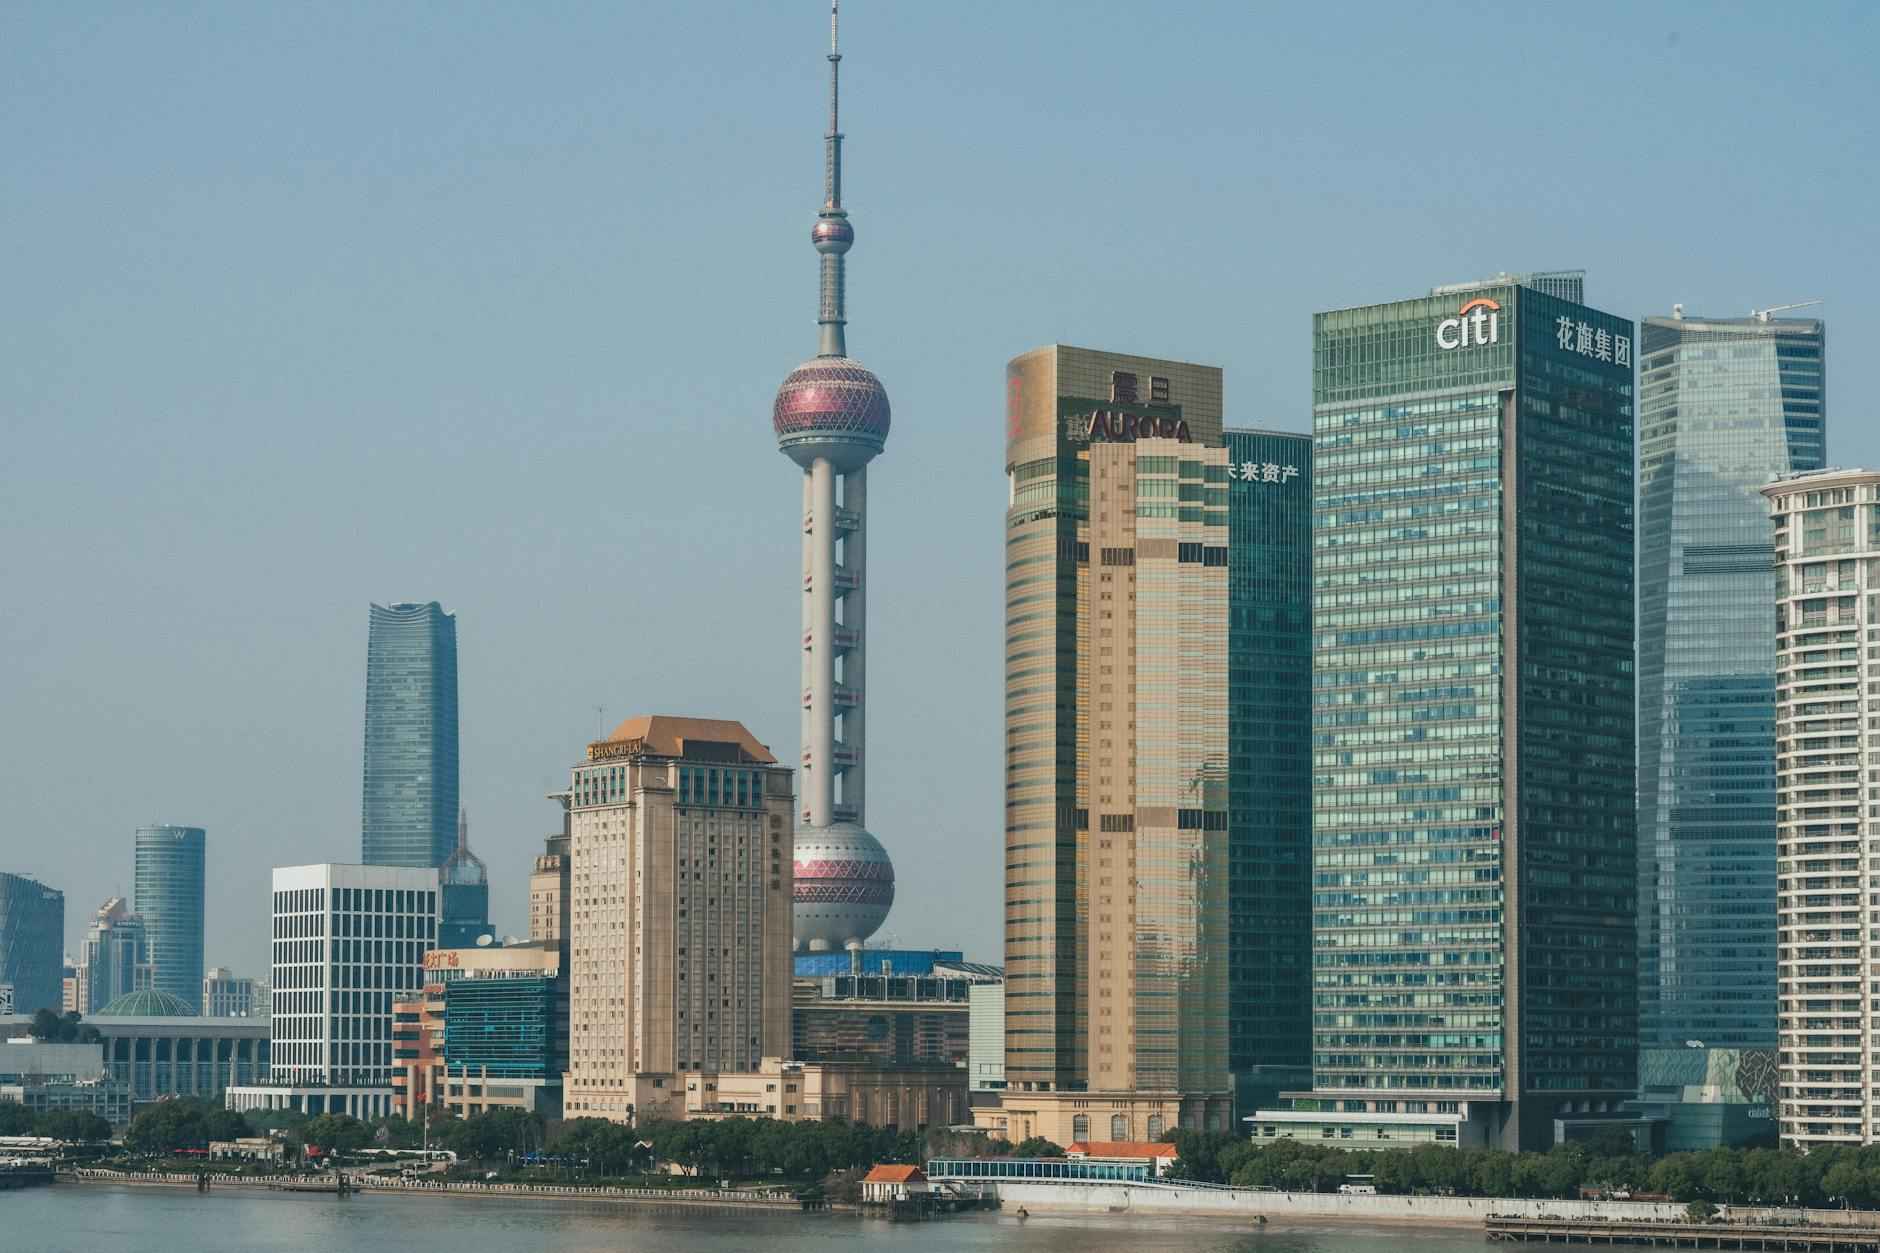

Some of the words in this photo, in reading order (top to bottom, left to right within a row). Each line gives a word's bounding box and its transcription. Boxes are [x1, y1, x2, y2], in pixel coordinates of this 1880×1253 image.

[1437, 304, 1498, 350] citi
[1555, 314, 1631, 369] 花旗集团
[1088, 408, 1193, 443] AURORA
